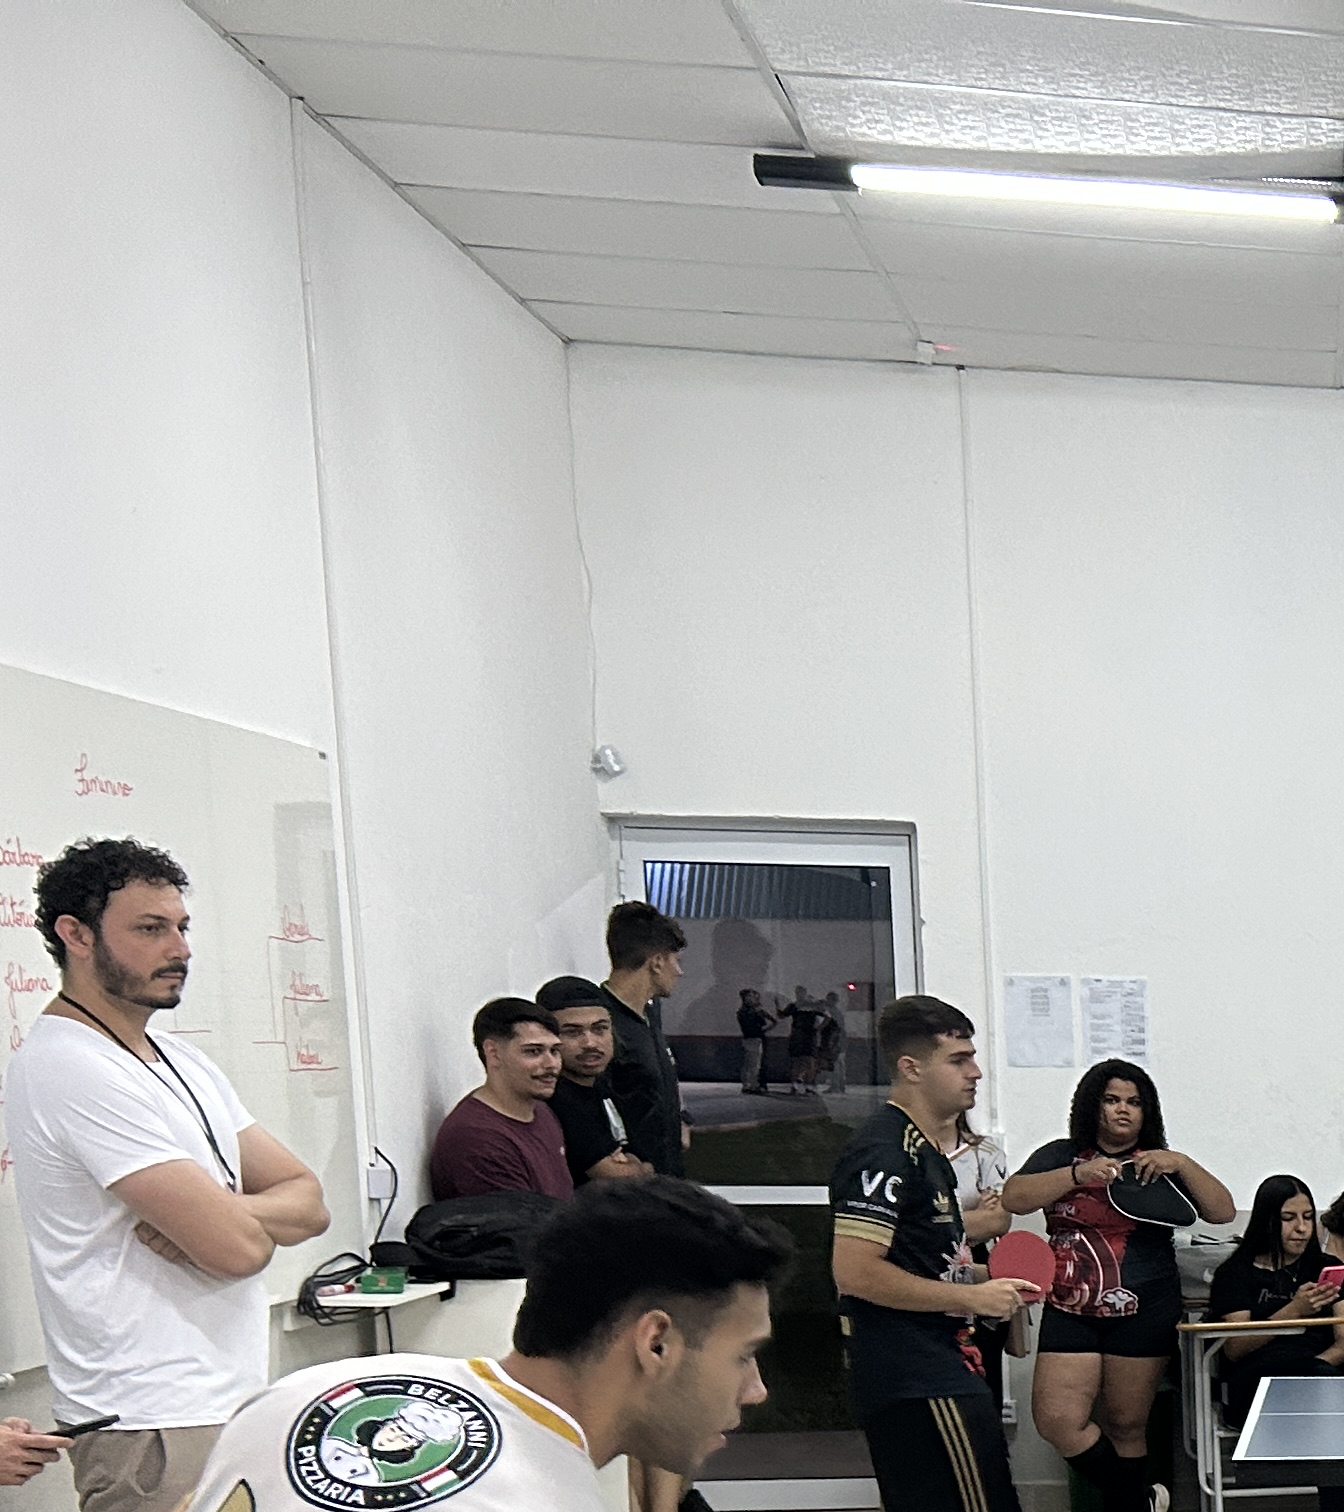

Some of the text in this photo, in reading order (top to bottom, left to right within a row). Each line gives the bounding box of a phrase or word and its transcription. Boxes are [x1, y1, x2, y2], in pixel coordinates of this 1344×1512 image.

[861, 1169, 903, 1203] VC
[407, 1383, 490, 1449] BELZANNI
[297, 1444, 367, 1506] PIZZARIA
